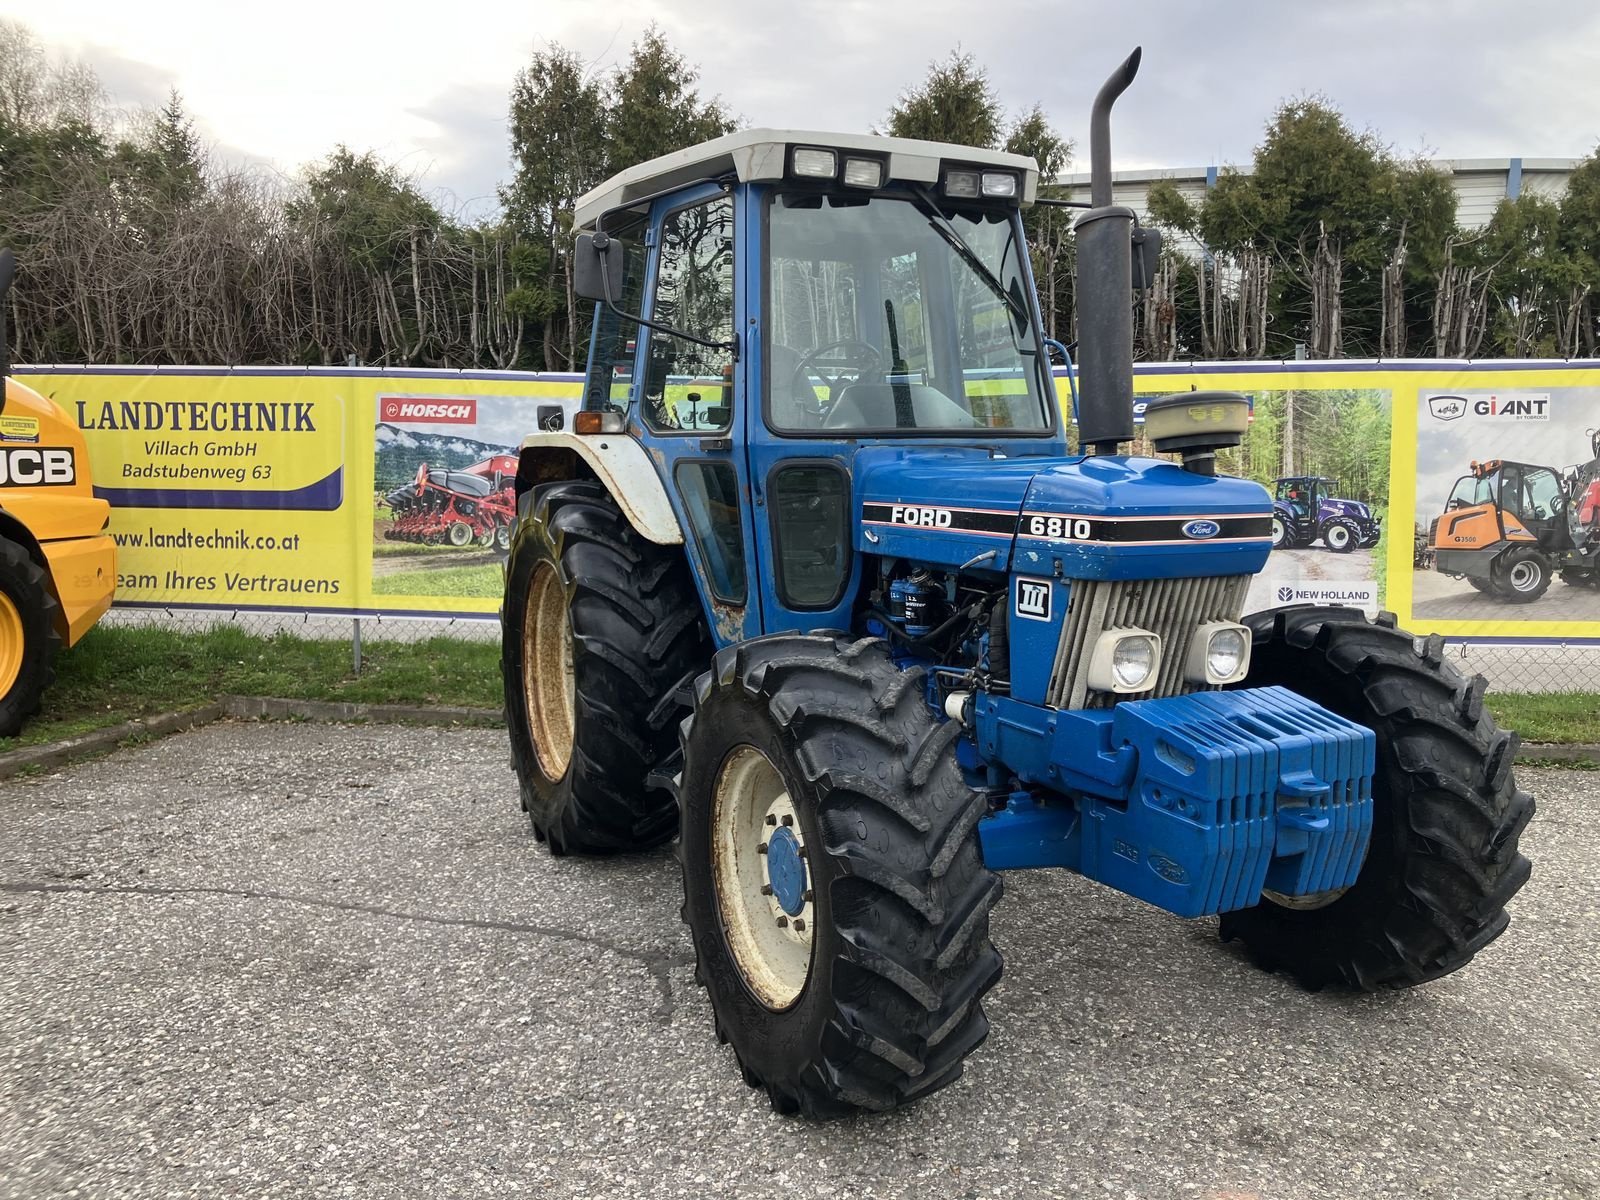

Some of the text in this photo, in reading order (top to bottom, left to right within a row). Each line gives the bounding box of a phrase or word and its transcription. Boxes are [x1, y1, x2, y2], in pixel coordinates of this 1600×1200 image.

[76, 401, 316, 432] LANDTECHNIK
[400, 404, 472, 419] HORSCH
[144, 441, 258, 457] Villach GmbH
[122, 463, 272, 482] Badstubenweg 63
[891, 506, 952, 528] FORD
[1030, 516, 1091, 540] 6810
[1191, 523, 1212, 534] Ford
[109, 527, 299, 551] ww.landtechnik.co.at
[116, 574, 157, 589] eam
[165, 571, 216, 590] Ihres
[225, 573, 340, 594] Vertrauens
[1295, 590, 1370, 600] NEW HOLLAND
